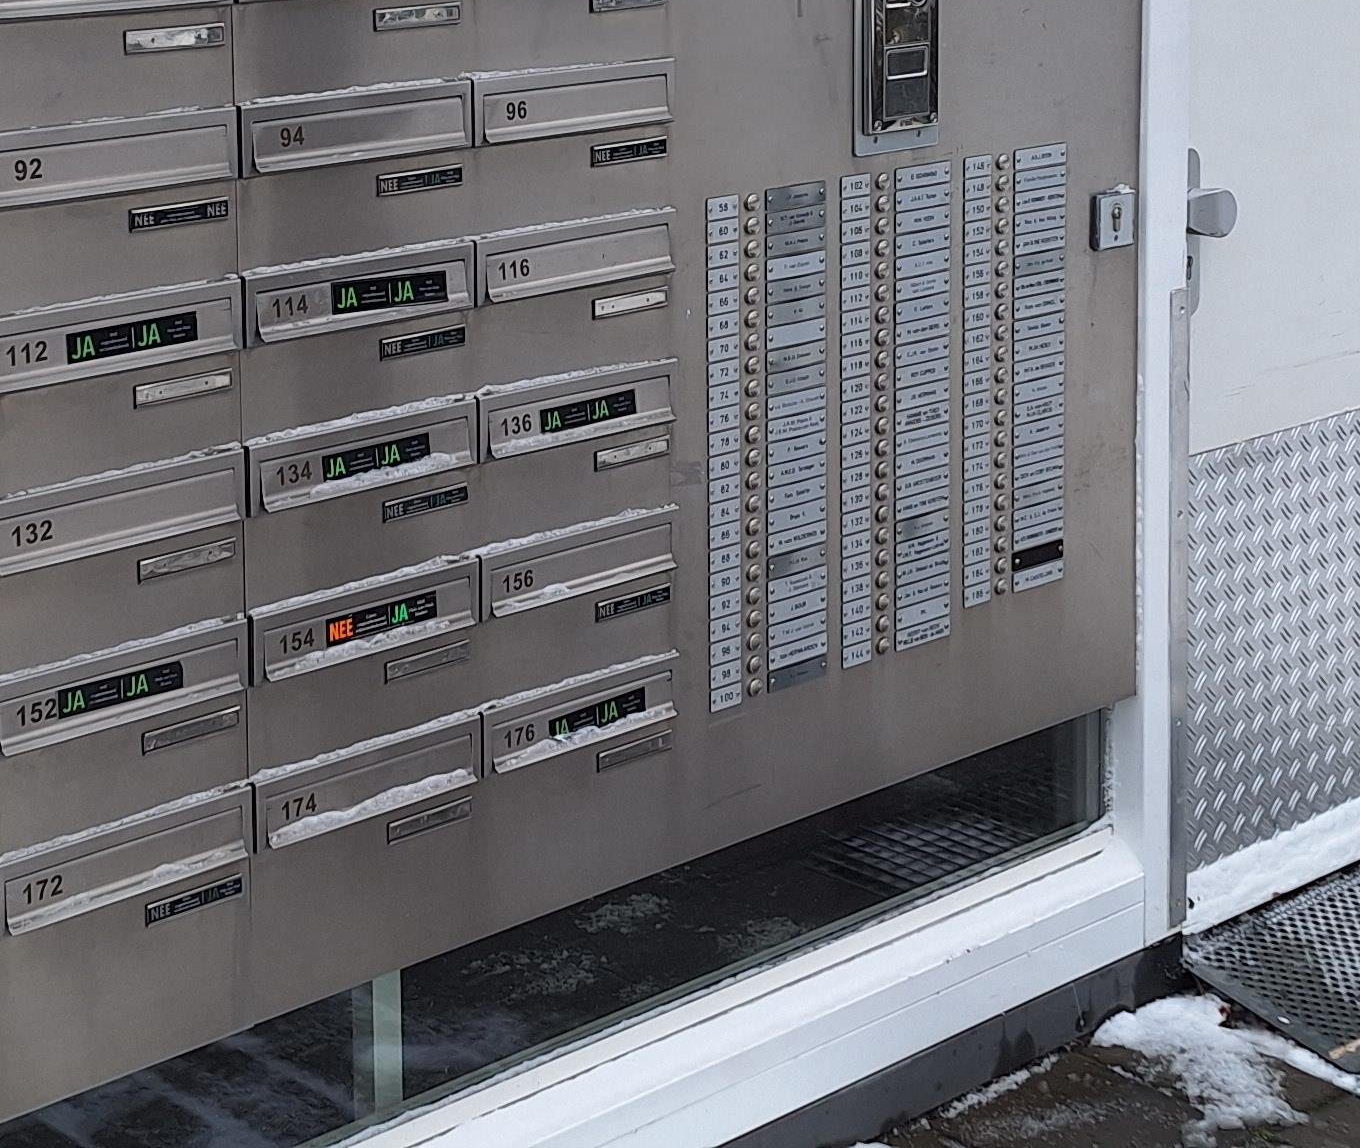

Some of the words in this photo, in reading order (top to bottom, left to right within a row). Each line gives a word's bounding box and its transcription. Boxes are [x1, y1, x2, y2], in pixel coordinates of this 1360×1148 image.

[506, 100, 528, 121] 96
[280, 125, 306, 148] 94
[595, 149, 612, 162] NEE
[14, 157, 44, 182] 92
[380, 178, 400, 193] NEE
[134, 214, 156, 228] NEE
[207, 203, 228, 218] NEE
[498, 258, 531, 281] 116
[272, 294, 309, 319] 114
[337, 286, 358, 309] JA
[394, 280, 414, 302] JA
[6, 339, 49, 367] 112
[71, 335, 96, 360] JA
[138, 323, 161, 348] JA
[384, 340, 403, 356] NEE
[500, 413, 532, 437] 136
[544, 410, 562, 431] JA
[592, 400, 609, 420] JA
[326, 456, 347, 478] JA
[381, 443, 401, 465] JA
[276, 460, 313, 487] 134
[386, 503, 405, 520] NEE
[11, 519, 54, 548] 132
[502, 569, 534, 594] 156
[329, 617, 354, 642] NEE
[392, 602, 409, 624] JA
[598, 603, 616, 618] NEE
[279, 627, 316, 655] 154
[62, 689, 86, 714] JA
[126, 673, 149, 697] JA
[16, 697, 58, 727] 152
[601, 700, 619, 724] JA
[504, 723, 536, 750] 176
[281, 792, 317, 822] 174
[23, 874, 64, 906] 172
[150, 903, 172, 921] NEE
